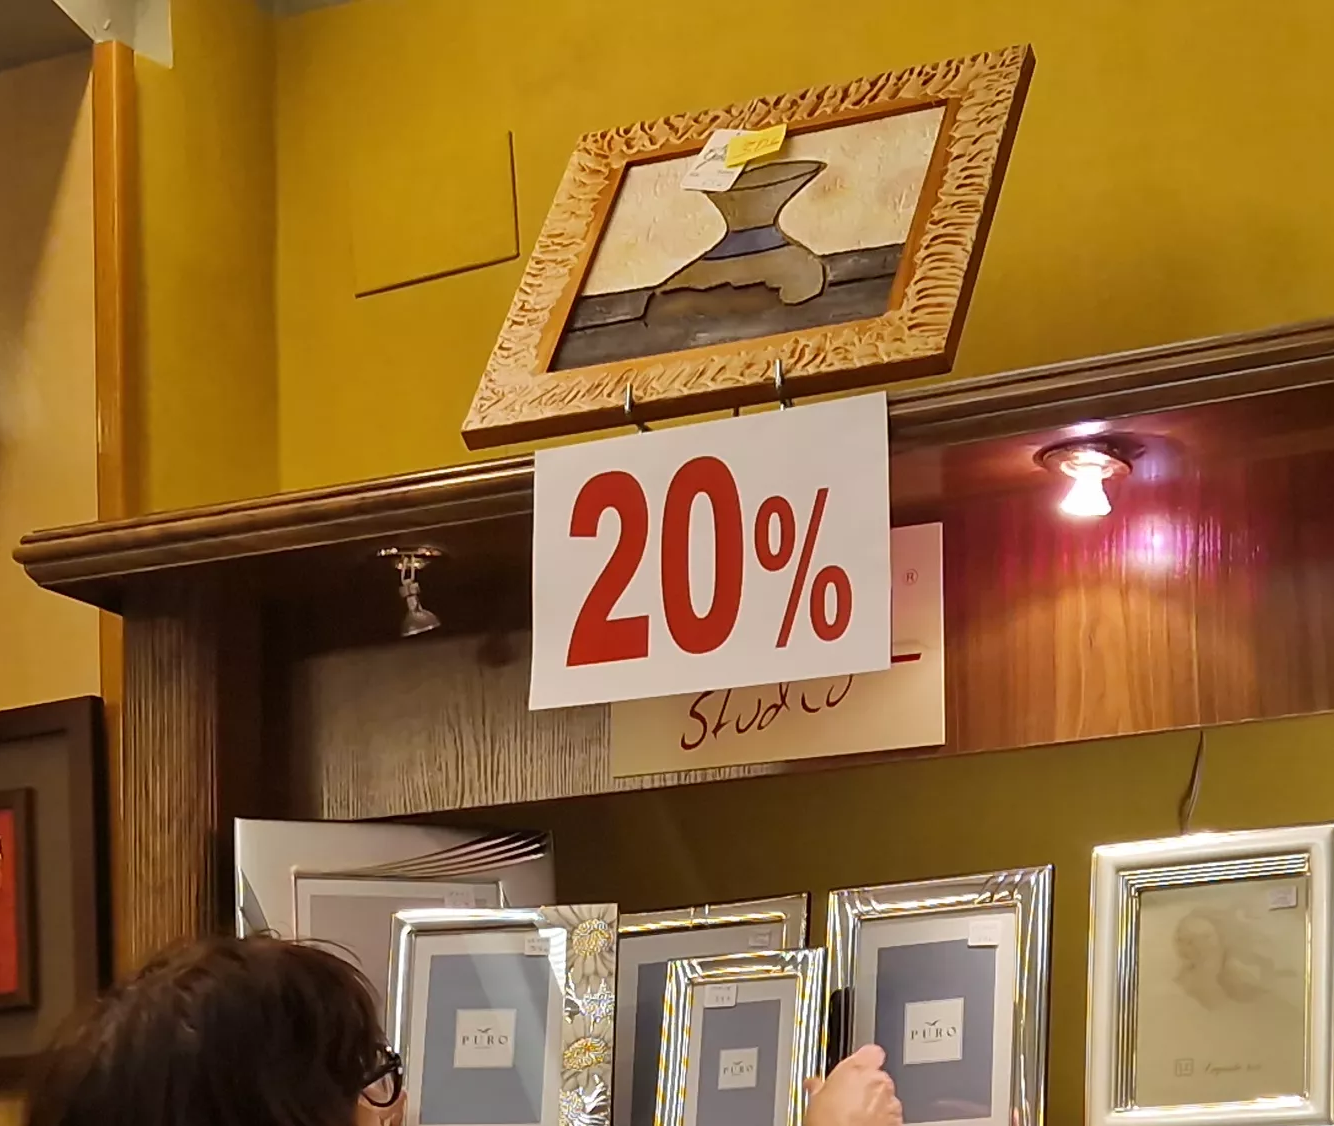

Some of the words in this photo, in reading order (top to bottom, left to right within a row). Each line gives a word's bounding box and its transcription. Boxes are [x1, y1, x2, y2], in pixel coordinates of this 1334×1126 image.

[566, 456, 853, 667] 20%
[461, 1034, 509, 1046] PURO
[910, 1026, 957, 1041] PURO
